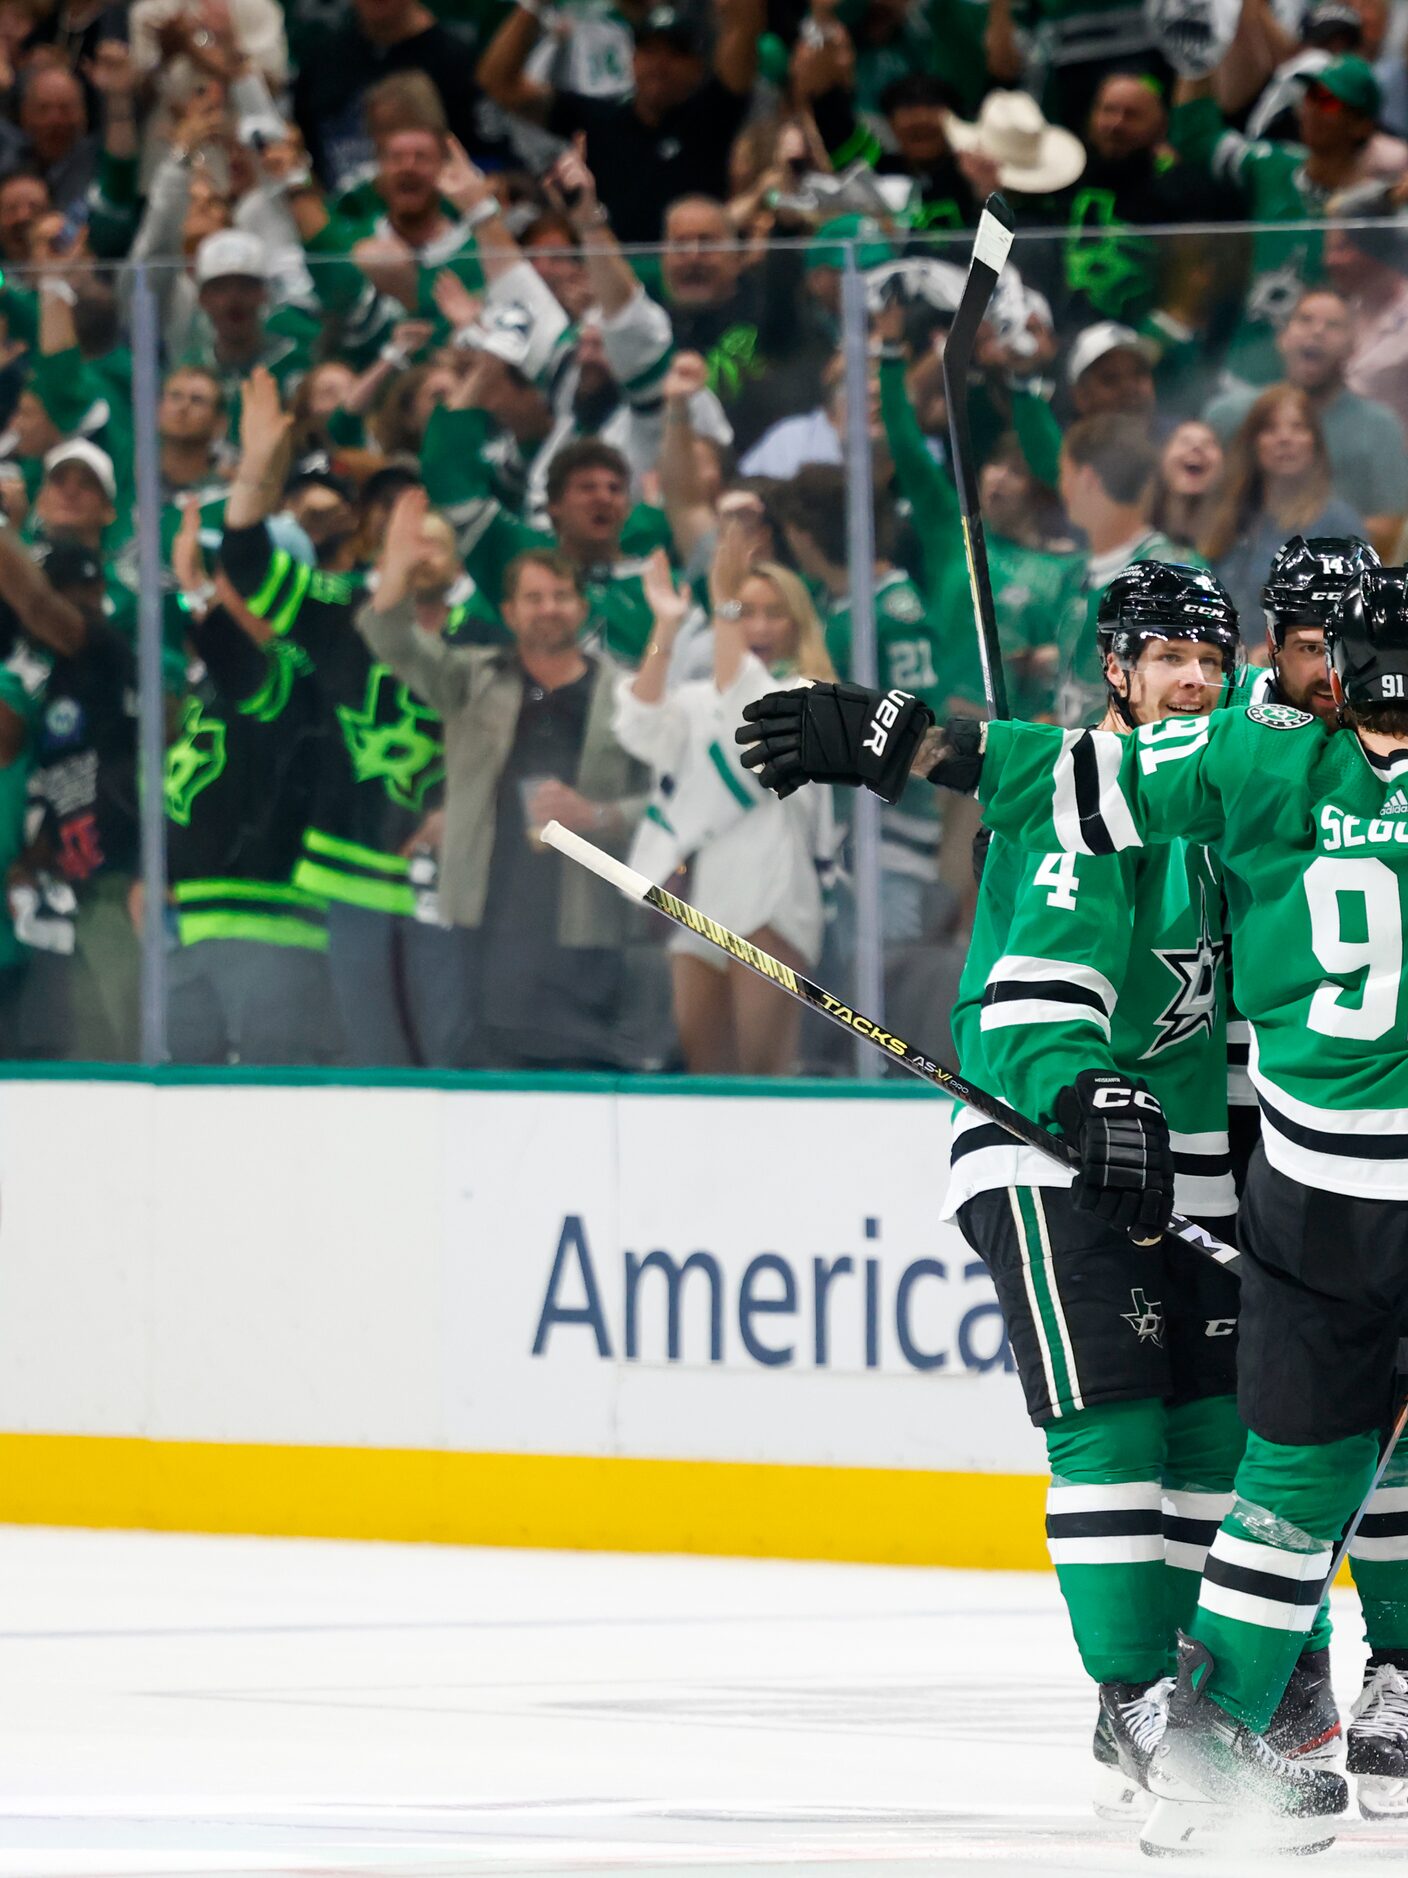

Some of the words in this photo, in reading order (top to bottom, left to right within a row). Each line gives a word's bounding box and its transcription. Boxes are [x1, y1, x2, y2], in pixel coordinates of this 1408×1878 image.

[1321, 557, 1343, 575] 14
[1184, 603, 1226, 618] CCM
[886, 638, 939, 688] 21
[1381, 674, 1405, 698] 91
[1138, 715, 1209, 775] 91
[1032, 852, 1080, 911] 4
[821, 994, 908, 1057] TACKS
[913, 1055, 953, 1082] AS-VI
[949, 1080, 970, 1094] PRO
[1092, 1087, 1167, 1121] CC
[531, 1215, 1019, 1376] America
